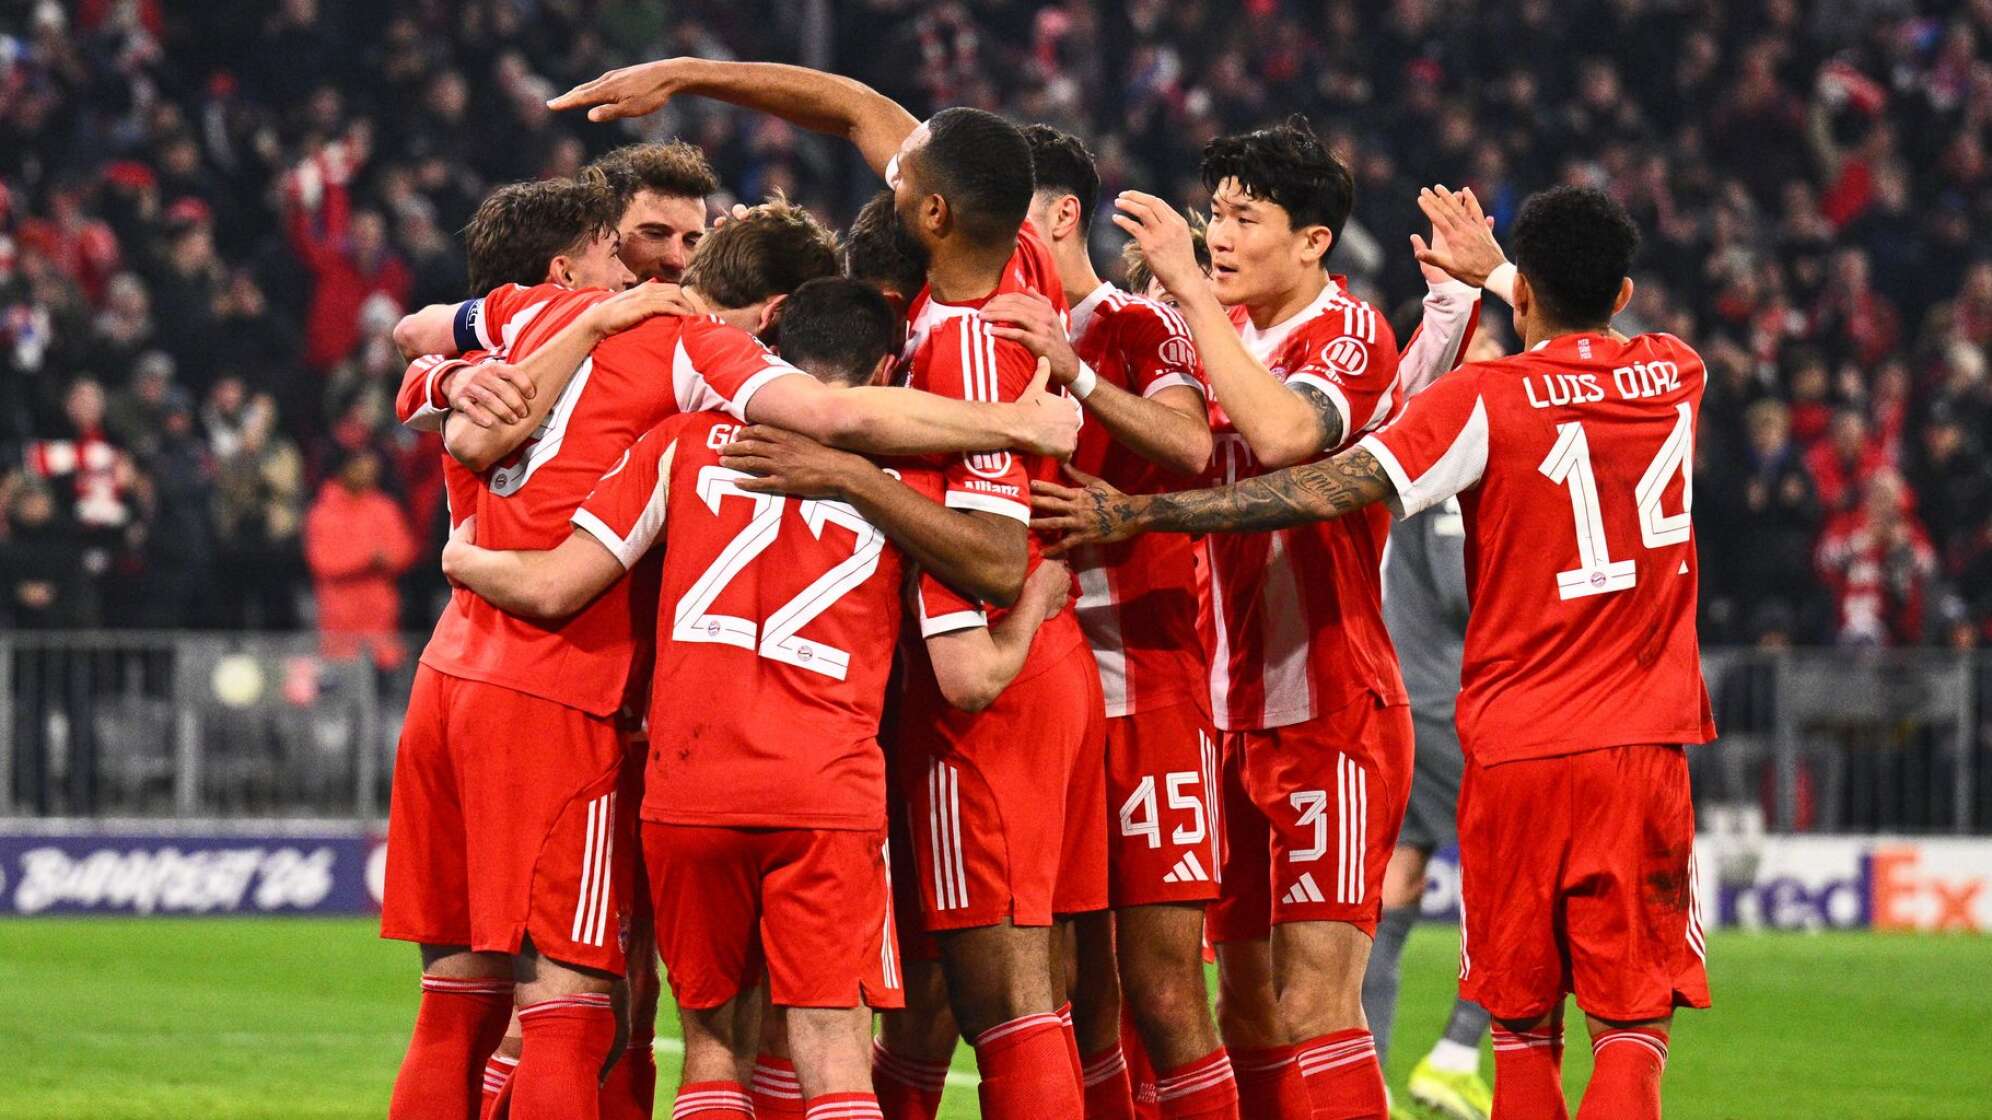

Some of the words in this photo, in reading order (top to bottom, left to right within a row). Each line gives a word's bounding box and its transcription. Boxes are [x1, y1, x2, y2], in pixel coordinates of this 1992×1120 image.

[1523, 373, 1605, 408] LUIS
[964, 479, 1020, 497] Allianz
[1537, 401, 1693, 600] 14
[672, 465, 886, 681] 22
[1119, 771, 1206, 849] 45
[1289, 790, 1328, 863] 3
